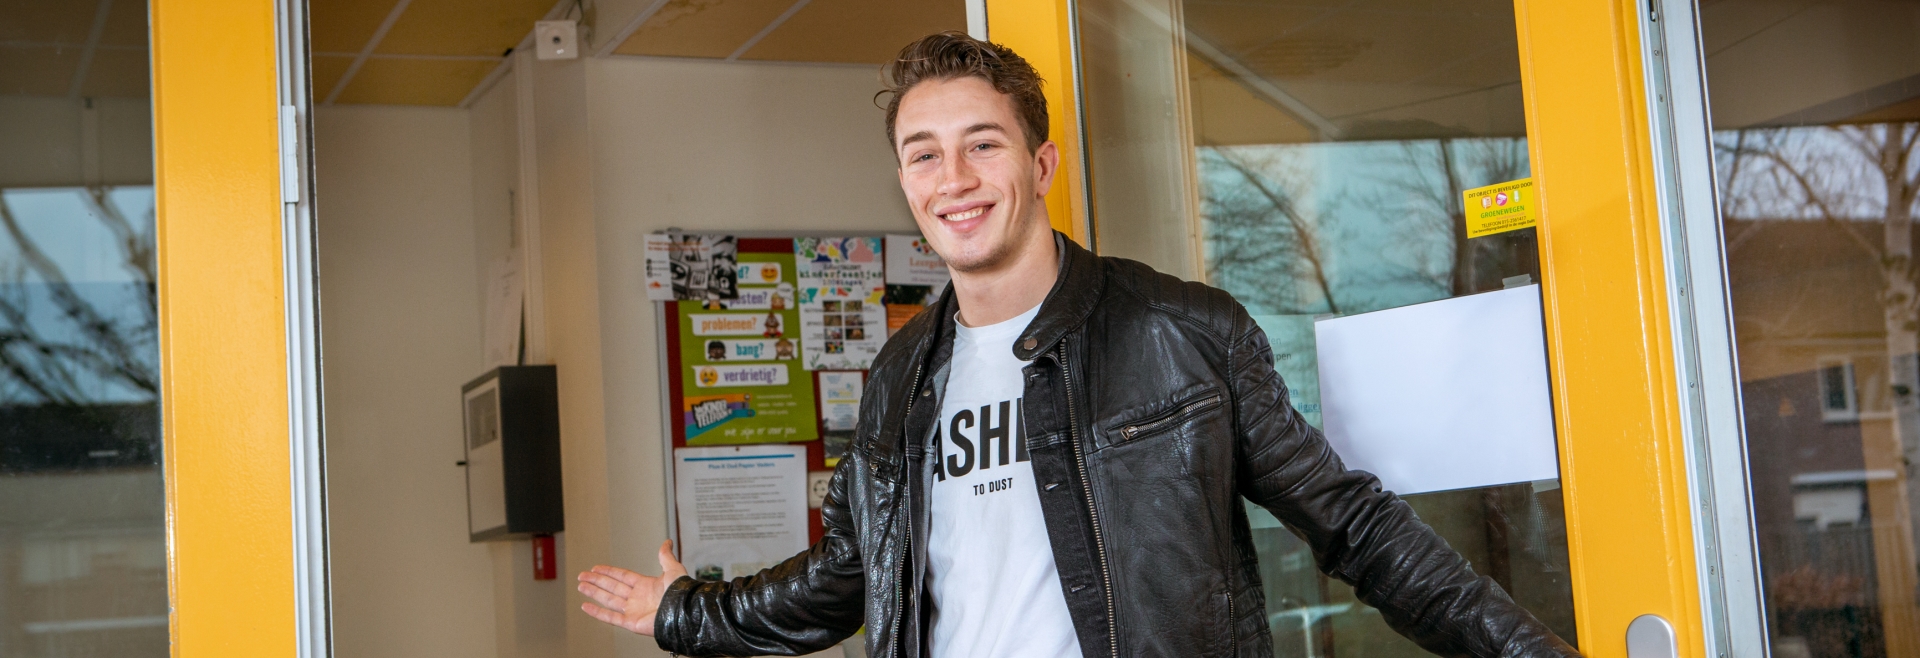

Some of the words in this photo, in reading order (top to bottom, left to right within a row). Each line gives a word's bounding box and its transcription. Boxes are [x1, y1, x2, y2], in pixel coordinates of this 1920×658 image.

[1476, 189, 1492, 197] OBJECT
[1498, 183, 1520, 193] BEVEILIGD
[1480, 205, 1525, 219] GROENEWEGEN
[1481, 220, 1501, 229] TELEFOON
[702, 316, 757, 333] problemen?
[735, 342, 765, 359] bang?
[724, 367, 777, 384] verdrietig?
[1297, 402, 1320, 413] ligge
[973, 483, 985, 496] TO
[988, 477, 1013, 493] DUST
